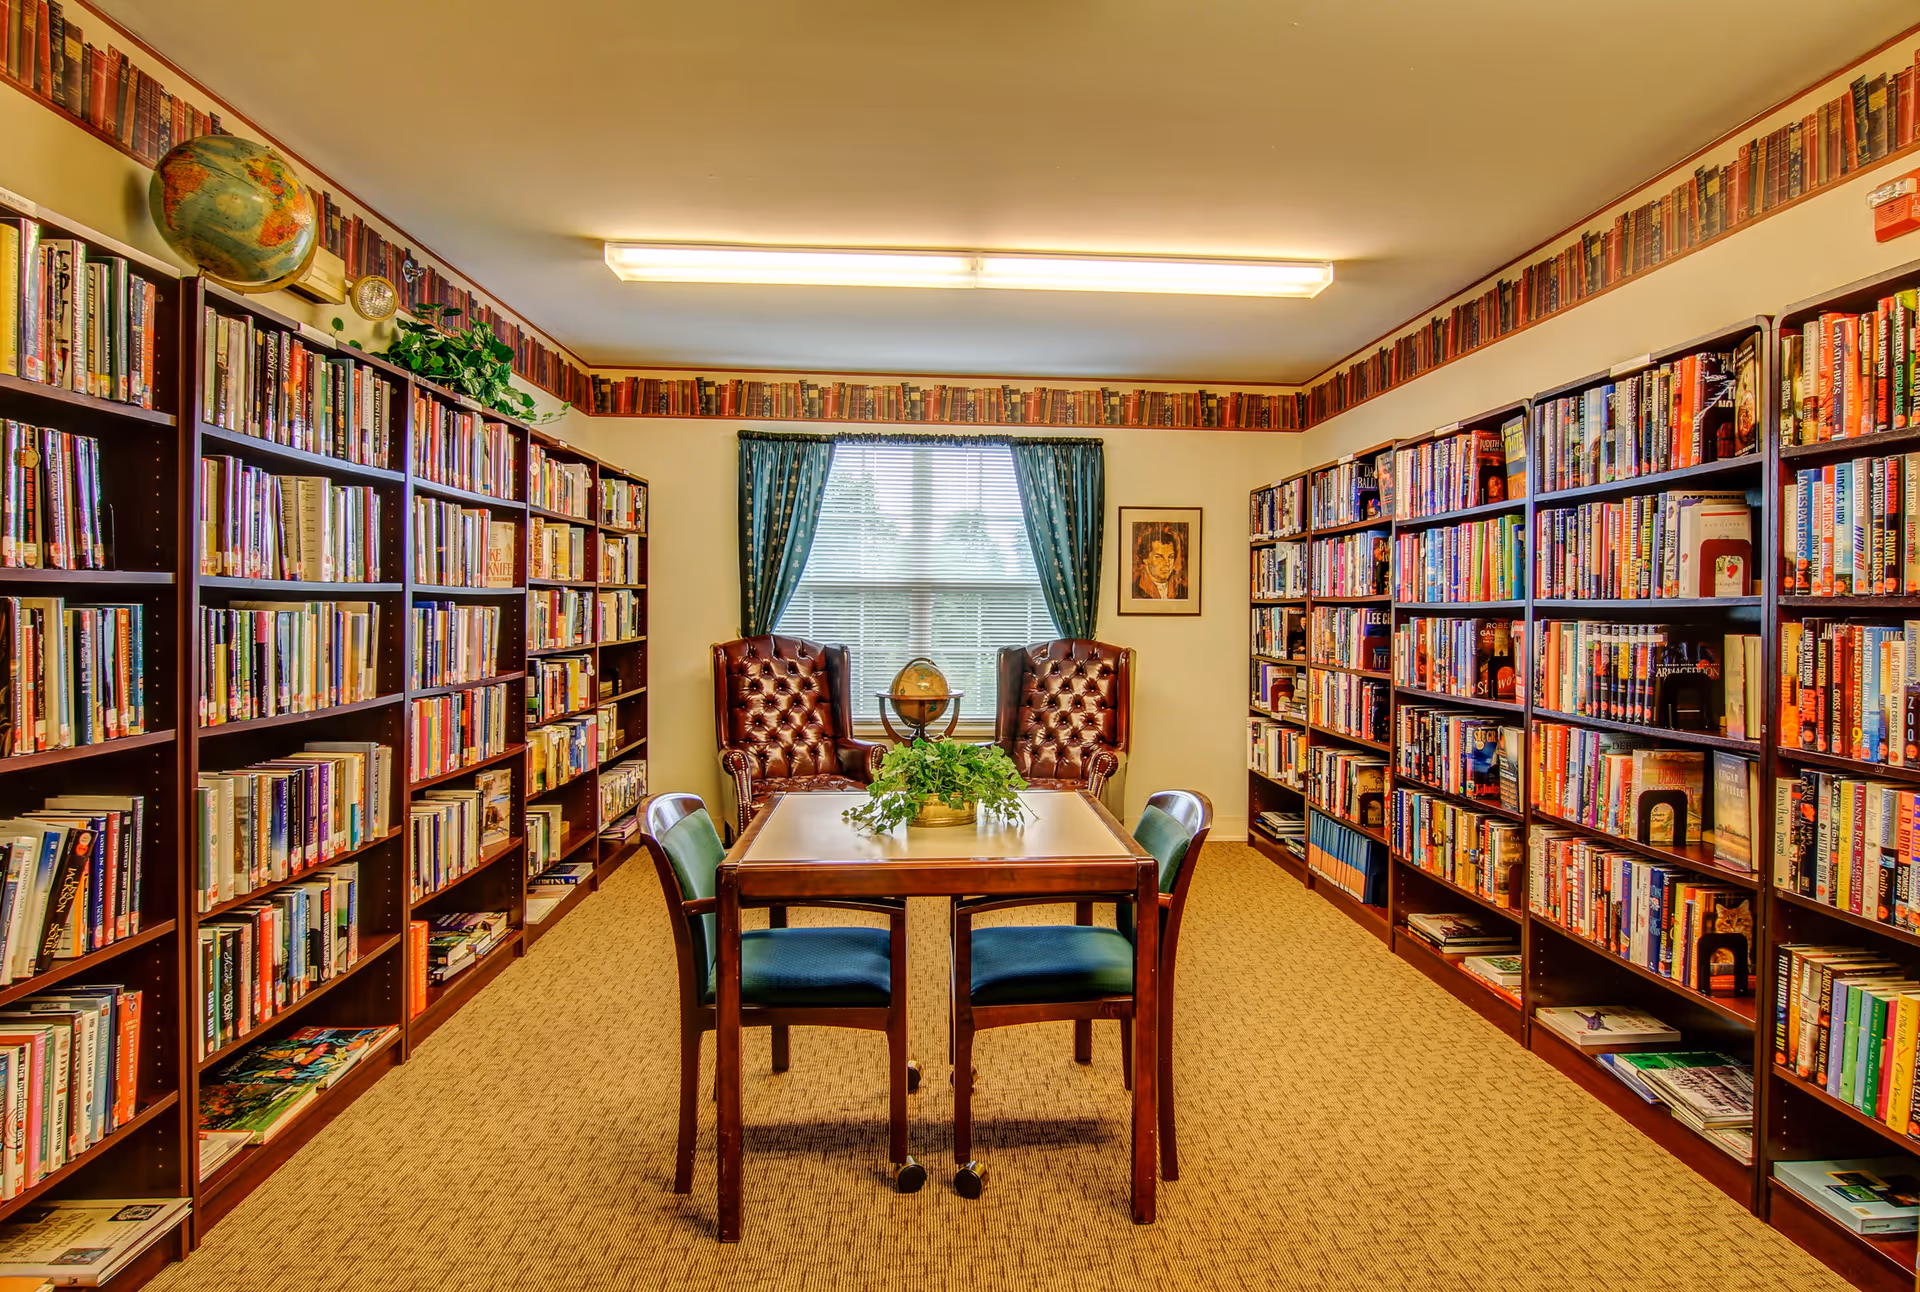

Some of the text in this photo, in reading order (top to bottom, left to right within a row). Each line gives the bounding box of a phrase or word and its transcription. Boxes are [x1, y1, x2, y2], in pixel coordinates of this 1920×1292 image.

[1894, 326, 1905, 362] PARETSKY
[1878, 320, 1888, 424] SARA PARETSKY BODY WORK
[1894, 364, 1904, 395] CRITICAL
[1894, 396, 1904, 414] MASS
[1798, 474, 1809, 507] JAMES
[1855, 484, 1864, 517] PATTERSON
[1873, 482, 1884, 516] PATTERSON
[1886, 480, 1898, 514] PATTERSON
[1906, 481, 1916, 516] PATTERSON
[1822, 503, 1834, 538] PATTERSON
[1906, 522, 1916, 541] HOPE
[1854, 525, 1864, 552] NYPD
[1873, 528, 1884, 548] ALEX
[1885, 530, 1896, 566] PRIVATE
[1906, 542, 1916, 552] TO
[1812, 534, 1820, 578] DON'T BLINK
[1854, 551, 1864, 570] RED
[1873, 551, 1883, 581] CROSS
[1906, 553, 1916, 565] DIE
[1366, 612, 1382, 626] LEE
[82, 670, 92, 694] CITY
[1802, 630, 1816, 723] JAMES PATTERSON GONE
[1852, 630, 1862, 726] JAMES PATTERSON
[1862, 650, 1872, 684] PATTERSON
[1890, 664, 1900, 694] PATTERSON
[1832, 688, 1841, 710] CROSS
[1890, 696, 1898, 710] ALEX
[1832, 710, 1841, 722] MY
[1832, 722, 1840, 742] HEART
[1854, 789, 1864, 827] LUANNE
[1818, 832, 1828, 863] MATTHEW
[1854, 829, 1864, 852] RICE
[1899, 829, 1910, 857] ROBB
[99, 857, 104, 866] IN
[56, 867, 77, 913] JACKSON
[67, 880, 80, 900] LISA
[1878, 868, 1889, 898] Guilty
[1901, 866, 1909, 900] PROMISES
[42, 922, 60, 956] SOULS
[1792, 956, 1800, 978] JAMES
[1822, 968, 1832, 992] KAREN
[1820, 994, 1830, 1013] ROSE
[1819, 1028, 1828, 1051] SCREAM
[16, 1080, 25, 1121] hypnotist
